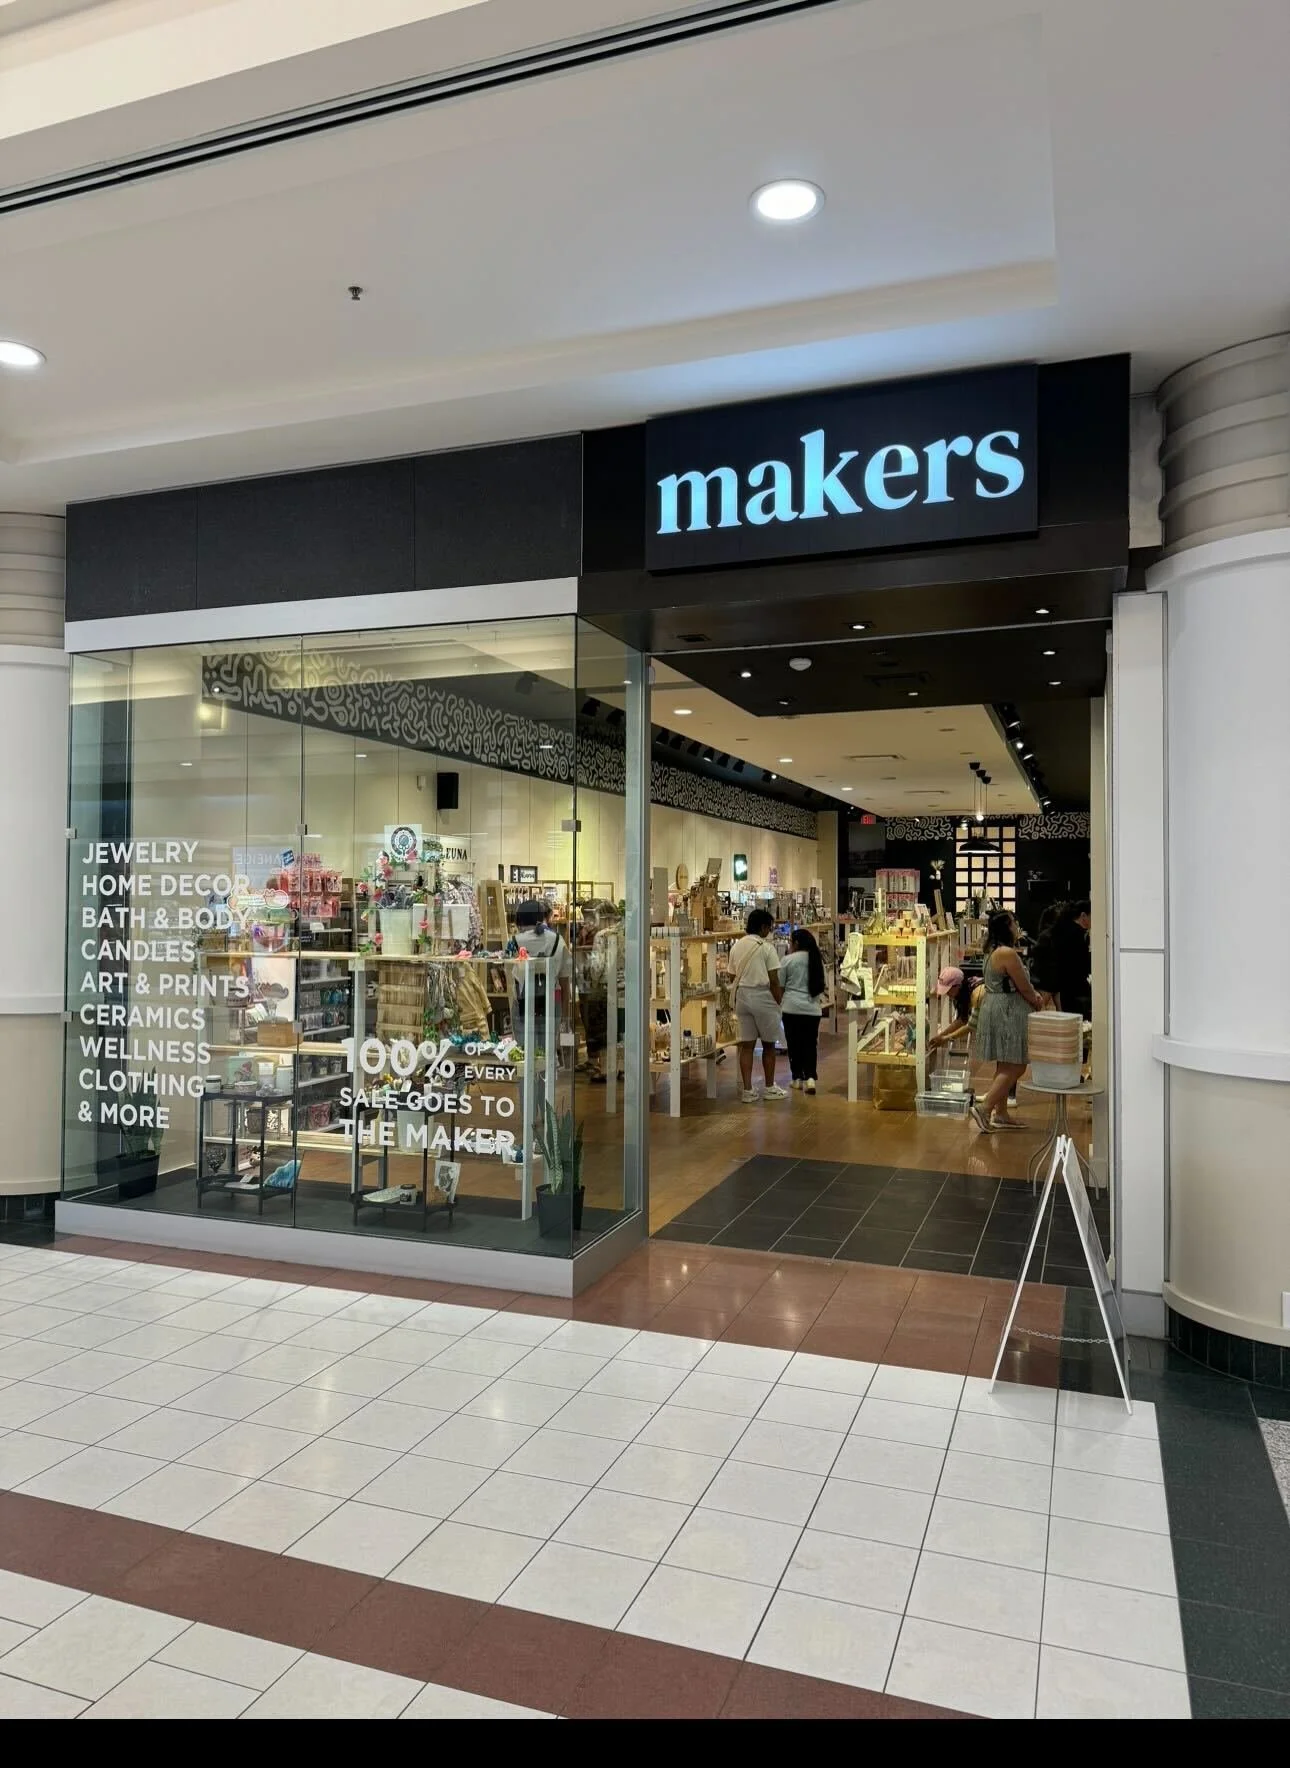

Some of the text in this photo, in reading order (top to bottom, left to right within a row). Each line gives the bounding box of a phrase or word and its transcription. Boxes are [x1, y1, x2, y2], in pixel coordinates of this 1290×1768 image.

[656, 428, 1025, 534] makers
[82, 841, 199, 865] JEWELRY
[83, 874, 250, 898] HOME DECOR
[82, 907, 250, 931] BATH & BODY
[81, 939, 196, 963] CANDLES
[80, 971, 250, 998] ART & PRINTS
[80, 1004, 205, 1030] CERAMICS
[80, 1036, 211, 1064] WELLNESS
[341, 1038, 456, 1079] 100%
[79, 1068, 205, 1098] CLOTHING
[464, 1065, 516, 1081] EVERY
[78, 1100, 170, 1129] & MORE
[339, 1087, 515, 1118] SALE GOES TO
[339, 1119, 516, 1156] THE MAKER
